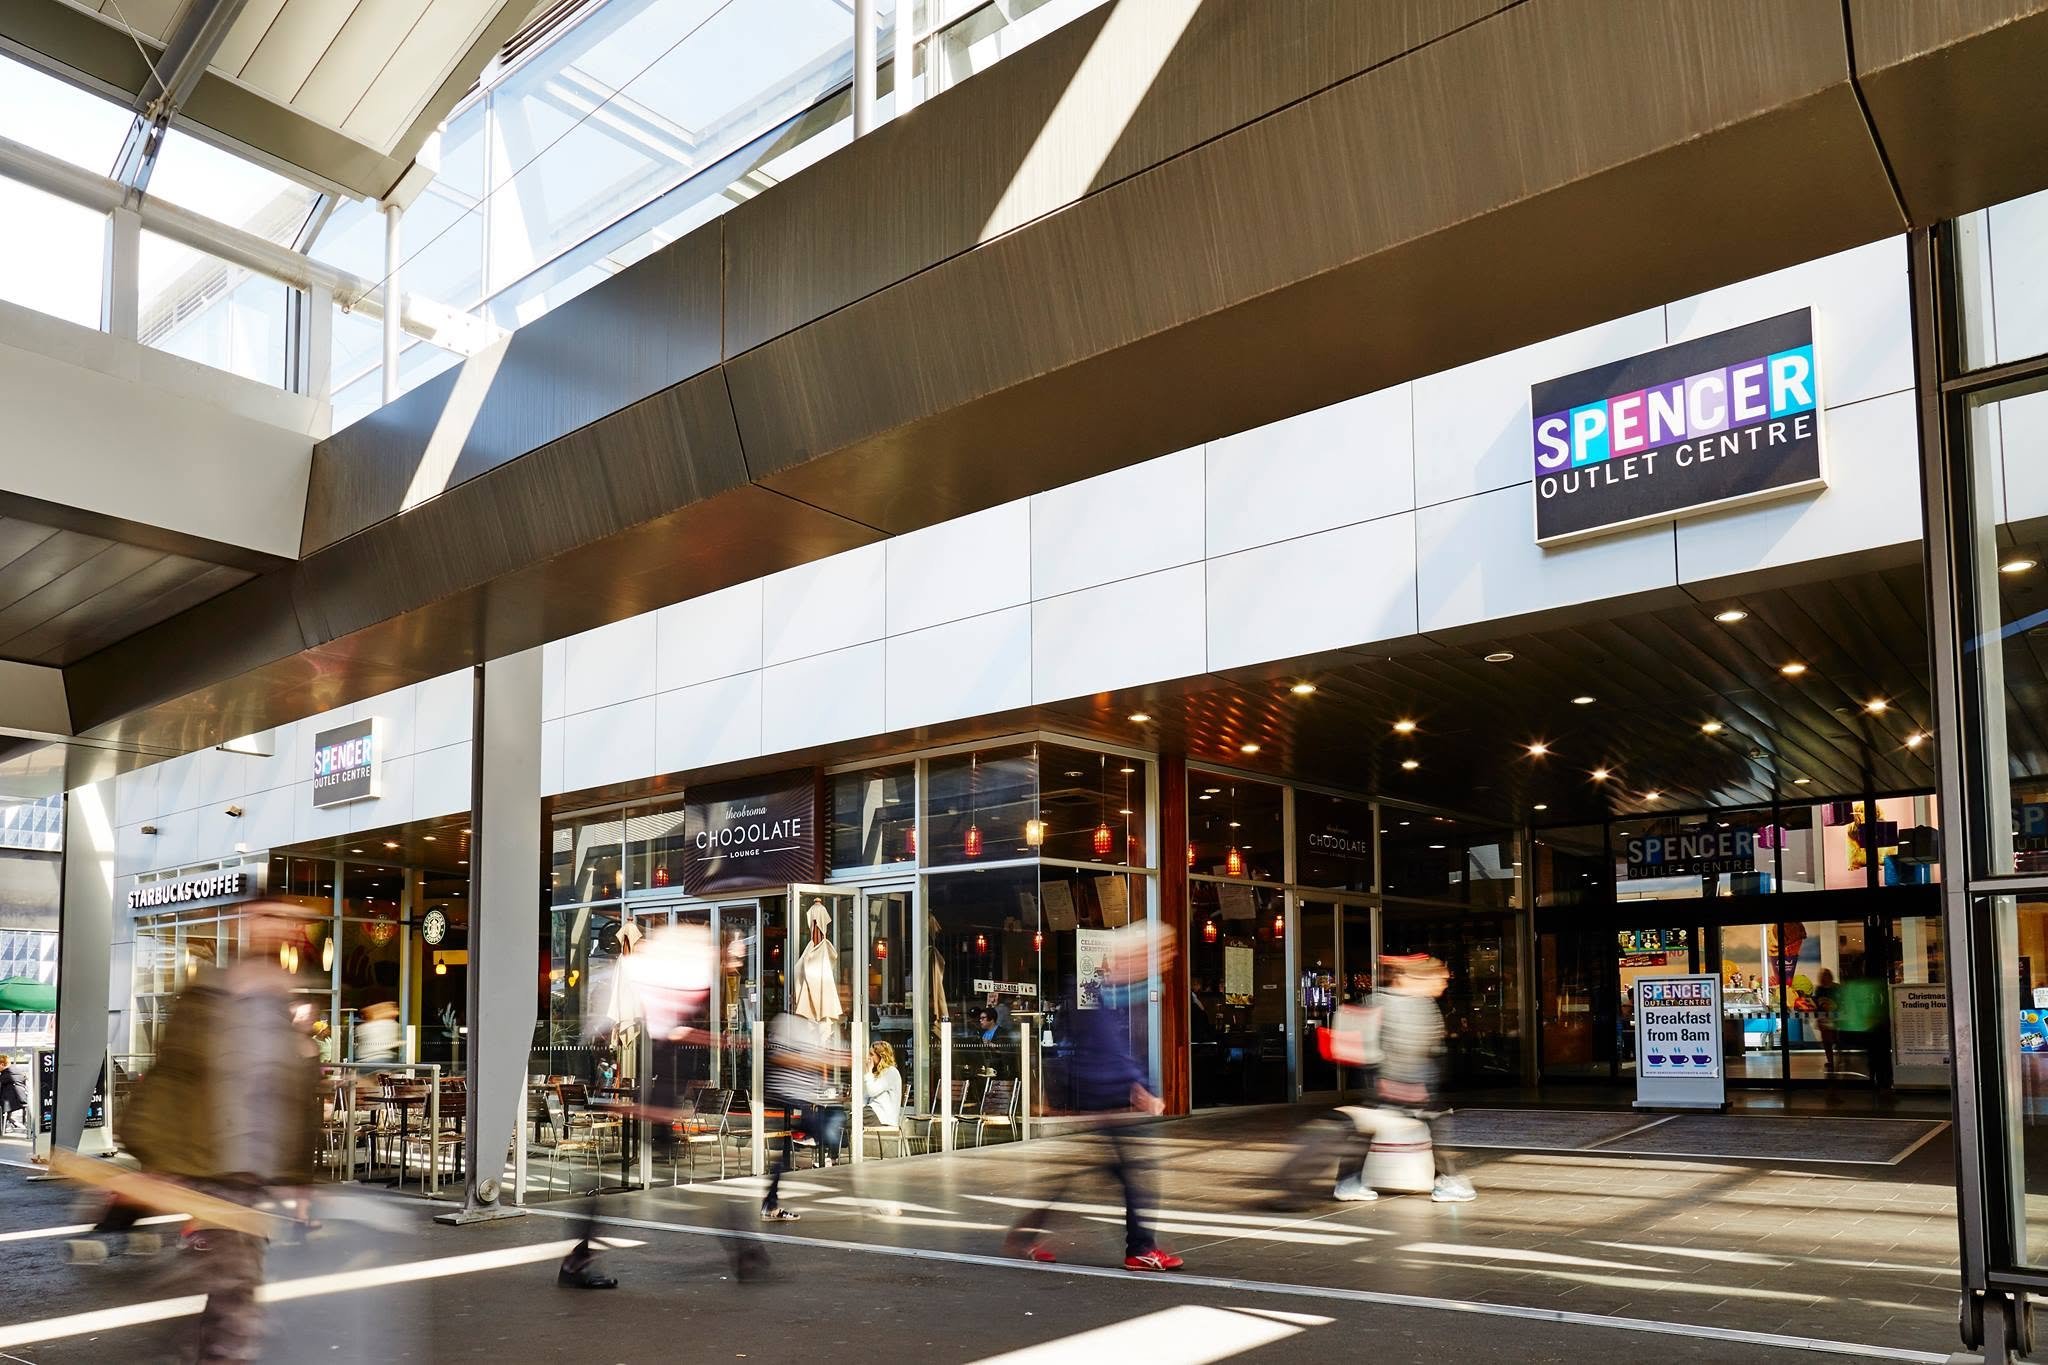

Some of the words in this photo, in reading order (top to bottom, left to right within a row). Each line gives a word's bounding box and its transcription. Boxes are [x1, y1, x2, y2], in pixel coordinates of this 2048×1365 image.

[1537, 354, 1813, 468] SPENCER
[1540, 452, 1658, 499] OUTLET
[1675, 415, 1812, 467] CENTRE
[315, 737, 372, 775] SPENCER
[314, 773, 340, 789] OUTLET
[342, 766, 371, 782] CENTRE
[725, 804, 768, 820] theobroma
[696, 818, 801, 849] CHOCOLATE
[730, 849, 760, 859] LOUNGE
[1628, 831, 1753, 863] SPENCER
[1692, 860, 1753, 873] CENTRE
[127, 881, 194, 909] STARBUCKS
[194, 873, 240, 898] COFFEE
[1643, 984, 1711, 999] SPENCER
[1907, 992, 1946, 1000] Christmas
[1644, 999, 1675, 1007] OUTLET
[1678, 998, 1711, 1006] CENTRE
[1901, 1001, 1930, 1009] Trading
[1645, 1011, 1712, 1025] Breakfast
[1647, 1028, 1678, 1042] from
[1680, 1028, 1710, 1042] 8am
